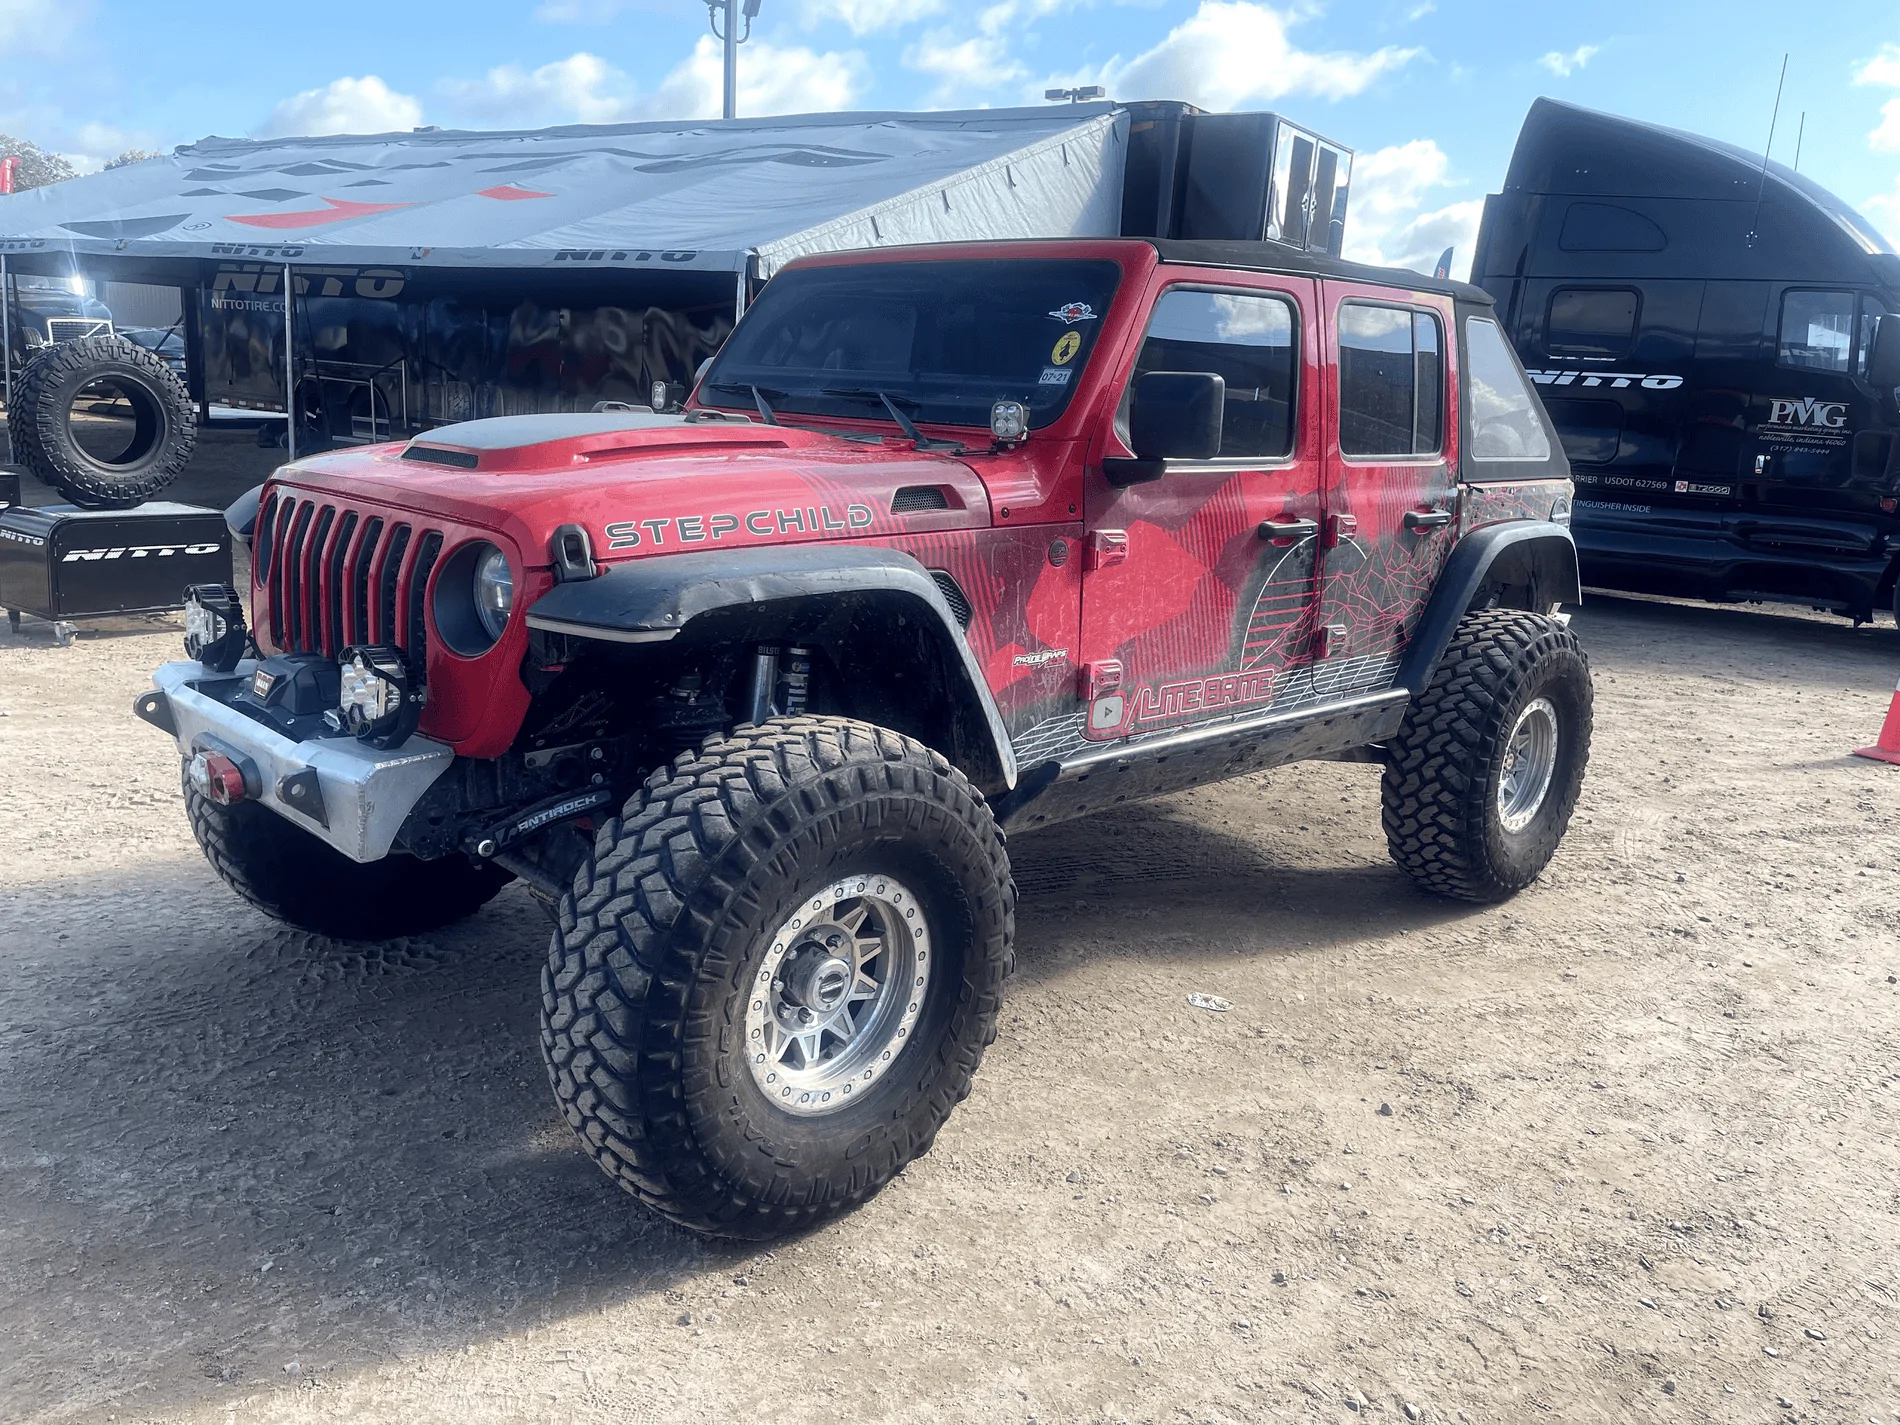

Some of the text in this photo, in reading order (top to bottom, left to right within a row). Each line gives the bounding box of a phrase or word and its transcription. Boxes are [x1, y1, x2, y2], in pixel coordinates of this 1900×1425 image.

[211, 242, 304, 257] NITTO
[553, 248, 697, 262] NITTO
[212, 263, 405, 298] NITTO
[1525, 369, 1684, 389] NITTO
[1768, 398, 1847, 428] PMG
[1756, 423, 1792, 431] performance
[1792, 425, 1822, 434] marketing
[1604, 476, 1635, 486] USDOT
[1635, 480, 1668, 490] 627569
[1622, 502, 1651, 513] INSIDE
[604, 504, 873, 550] STEPCHILD
[0, 529, 44, 546] NITTO
[62, 543, 221, 562] NITTO
[517, 795, 598, 832] ANTIROCK
